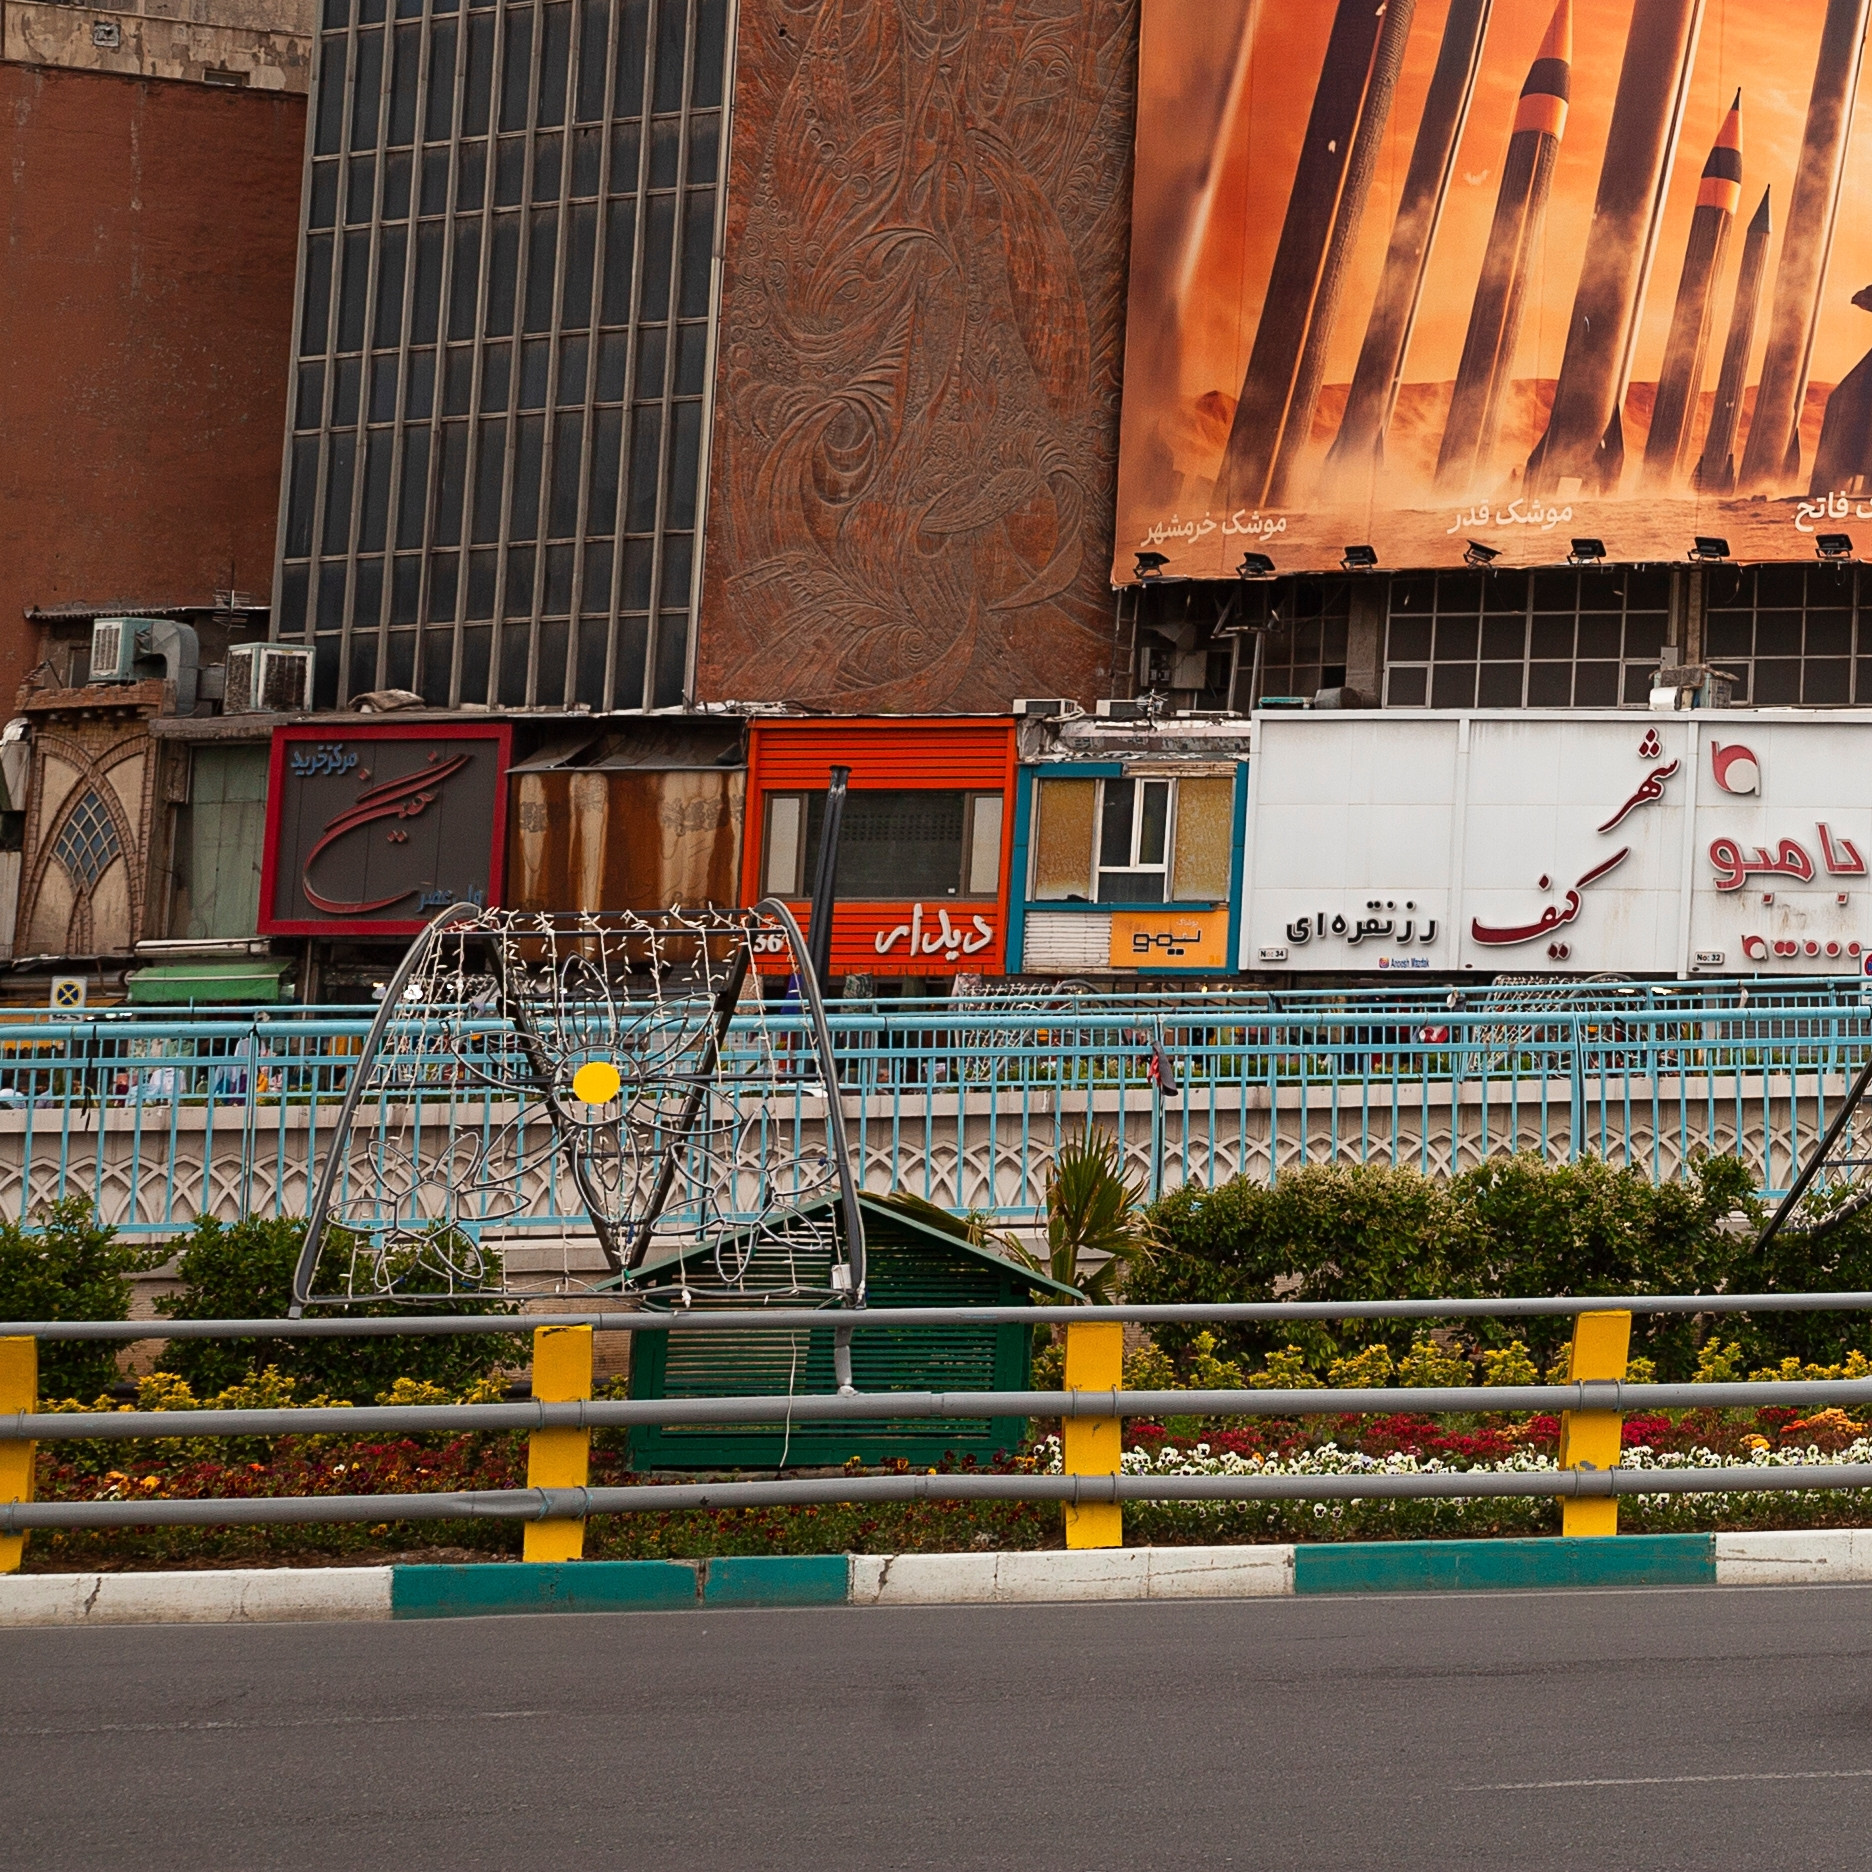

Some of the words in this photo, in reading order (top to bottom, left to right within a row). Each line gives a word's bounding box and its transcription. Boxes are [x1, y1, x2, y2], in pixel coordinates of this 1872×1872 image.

[1140, 511, 1218, 548] خرمشهر
[1221, 508, 1288, 542] موشک
[1447, 497, 1490, 534] قدر
[1495, 498, 1574, 531] موشک
[1794, 490, 1850, 533] فاتح
[1596, 727, 1682, 835] شهر
[1707, 821, 1869, 907] بامبو
[1470, 846, 1632, 960] کیف
[1696, 953, 1710, 962] No:
[1711, 953, 1722, 962] 32
